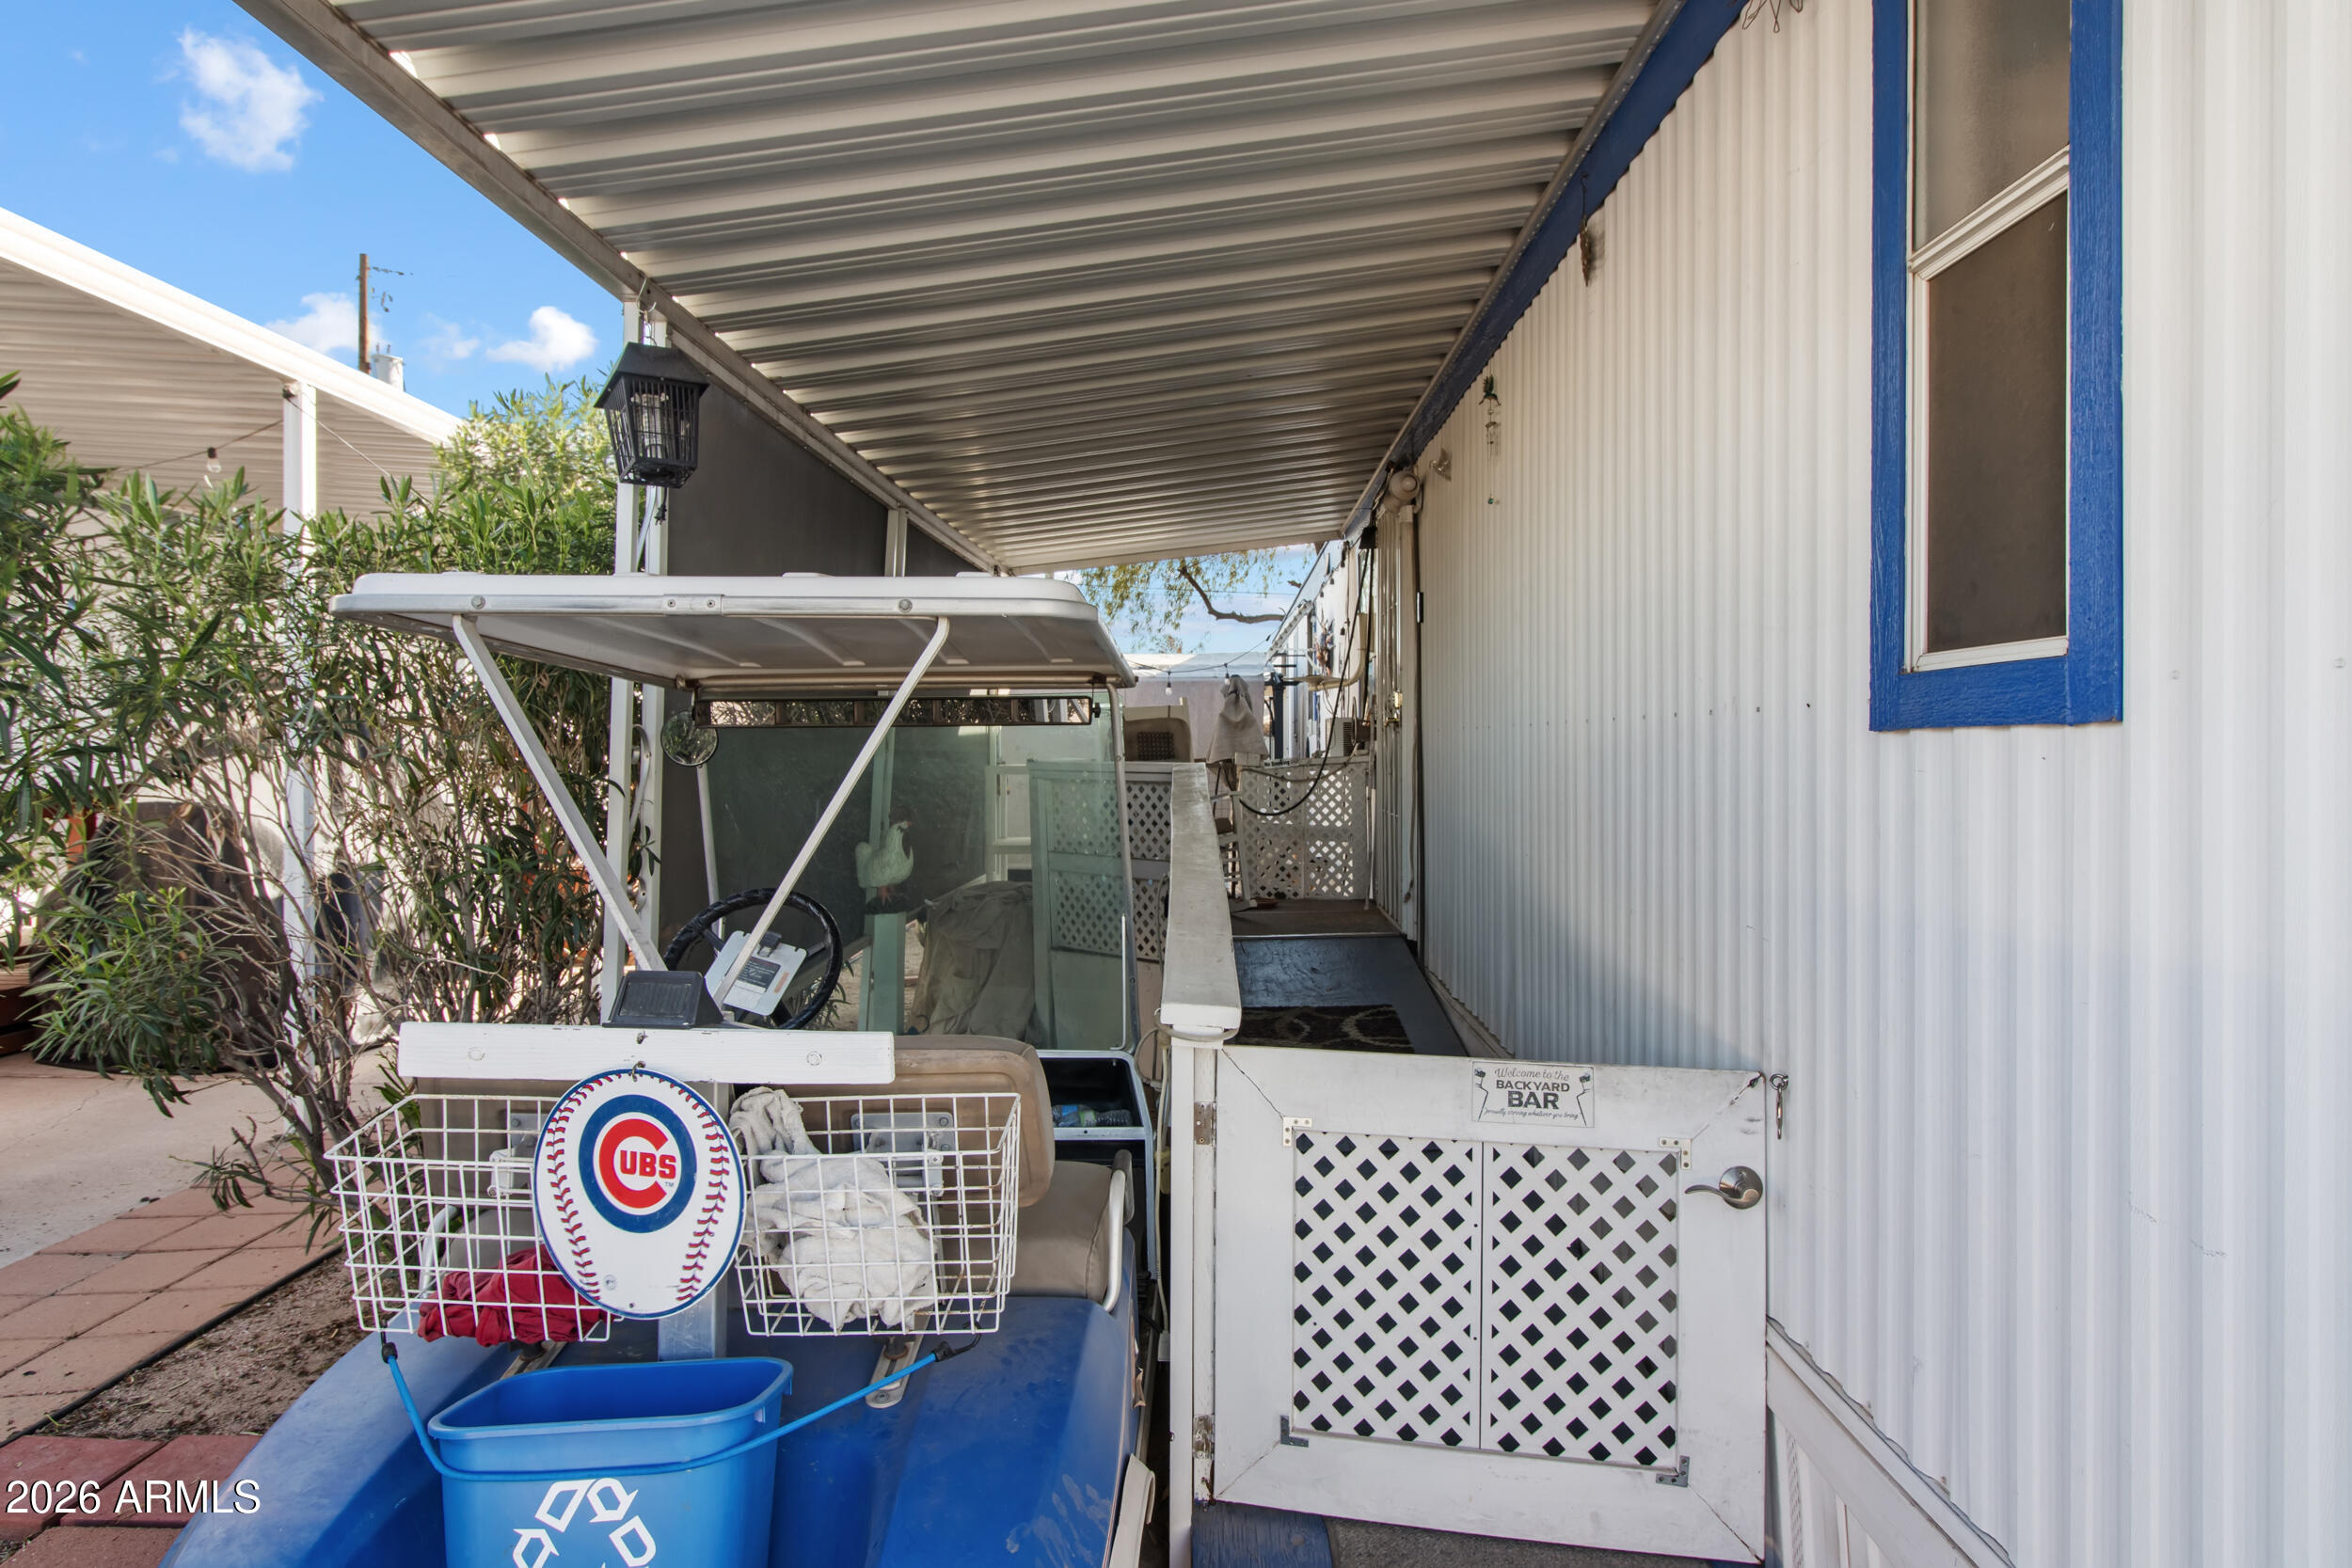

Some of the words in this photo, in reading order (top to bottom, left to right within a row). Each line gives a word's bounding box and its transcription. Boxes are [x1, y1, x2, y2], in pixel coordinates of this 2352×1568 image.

[1495, 1068, 1540, 1078] Welcome
[1543, 1069, 1552, 1079] to
[1554, 1070, 1569, 1081] the
[1496, 1080, 1570, 1092] BACKYARD
[1508, 1090, 1559, 1109] BAR
[598, 1118, 676, 1209] CUBS
